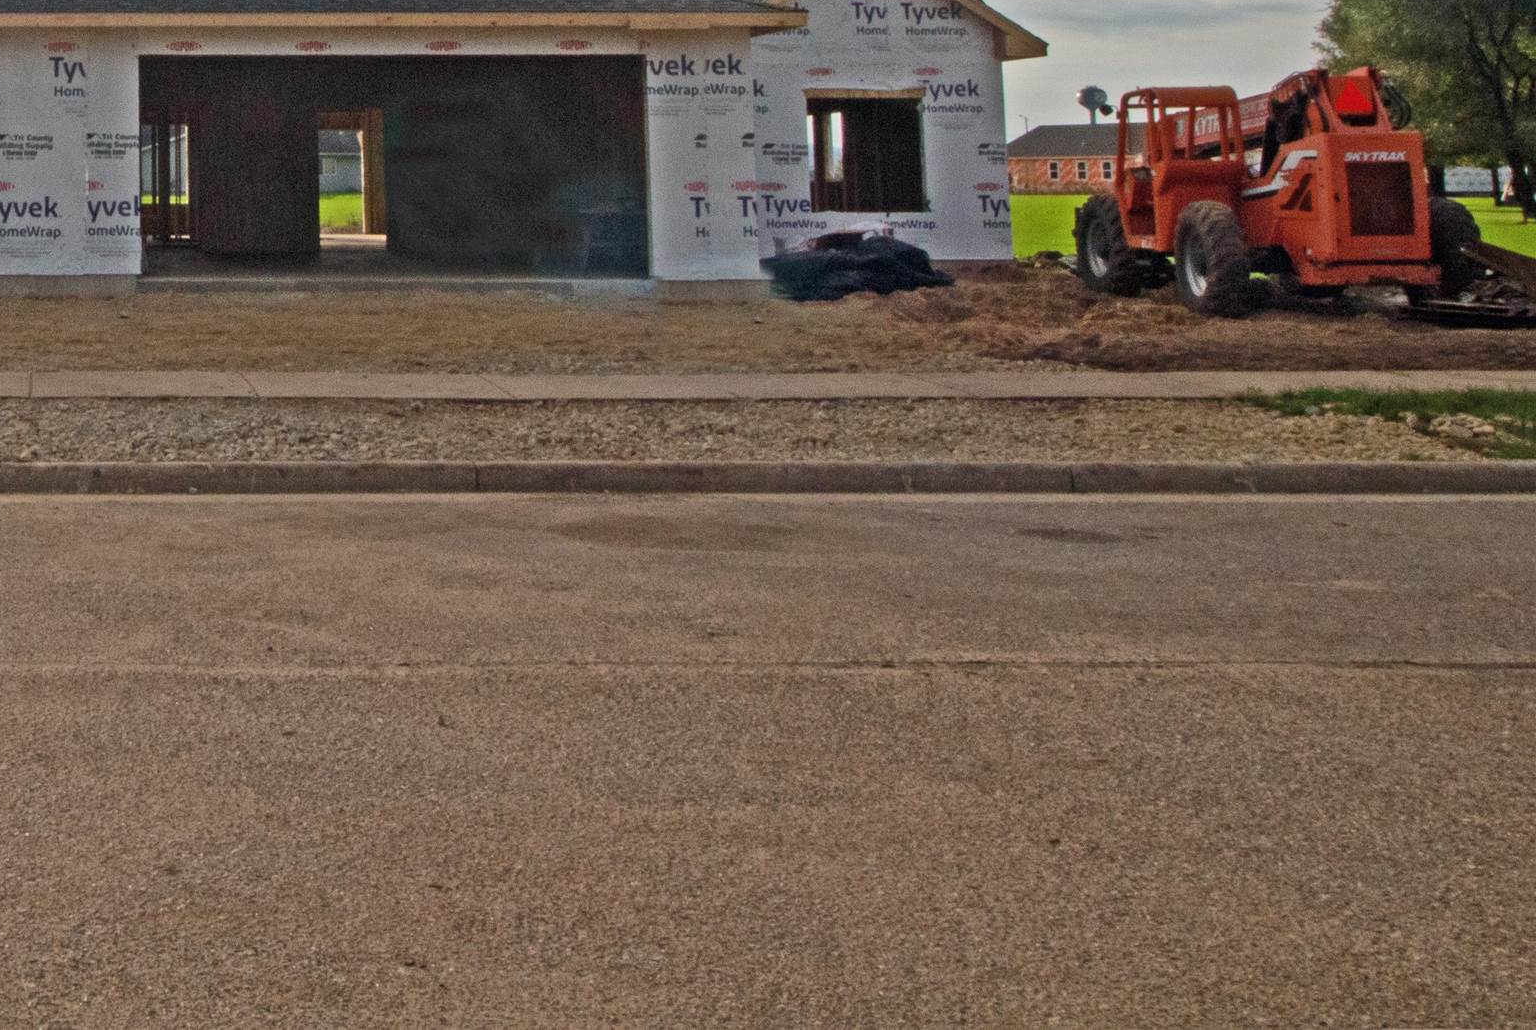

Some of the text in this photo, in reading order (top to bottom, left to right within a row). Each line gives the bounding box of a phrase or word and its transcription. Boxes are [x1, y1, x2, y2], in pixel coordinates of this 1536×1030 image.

[900, 2, 962, 24] Tyvek
[905, 26, 966, 36] HomeWrap
[923, 105, 983, 114] HomeWrap
[1344, 151, 1407, 162] SKYTRAK
[766, 220, 827, 230] HomeWrap
